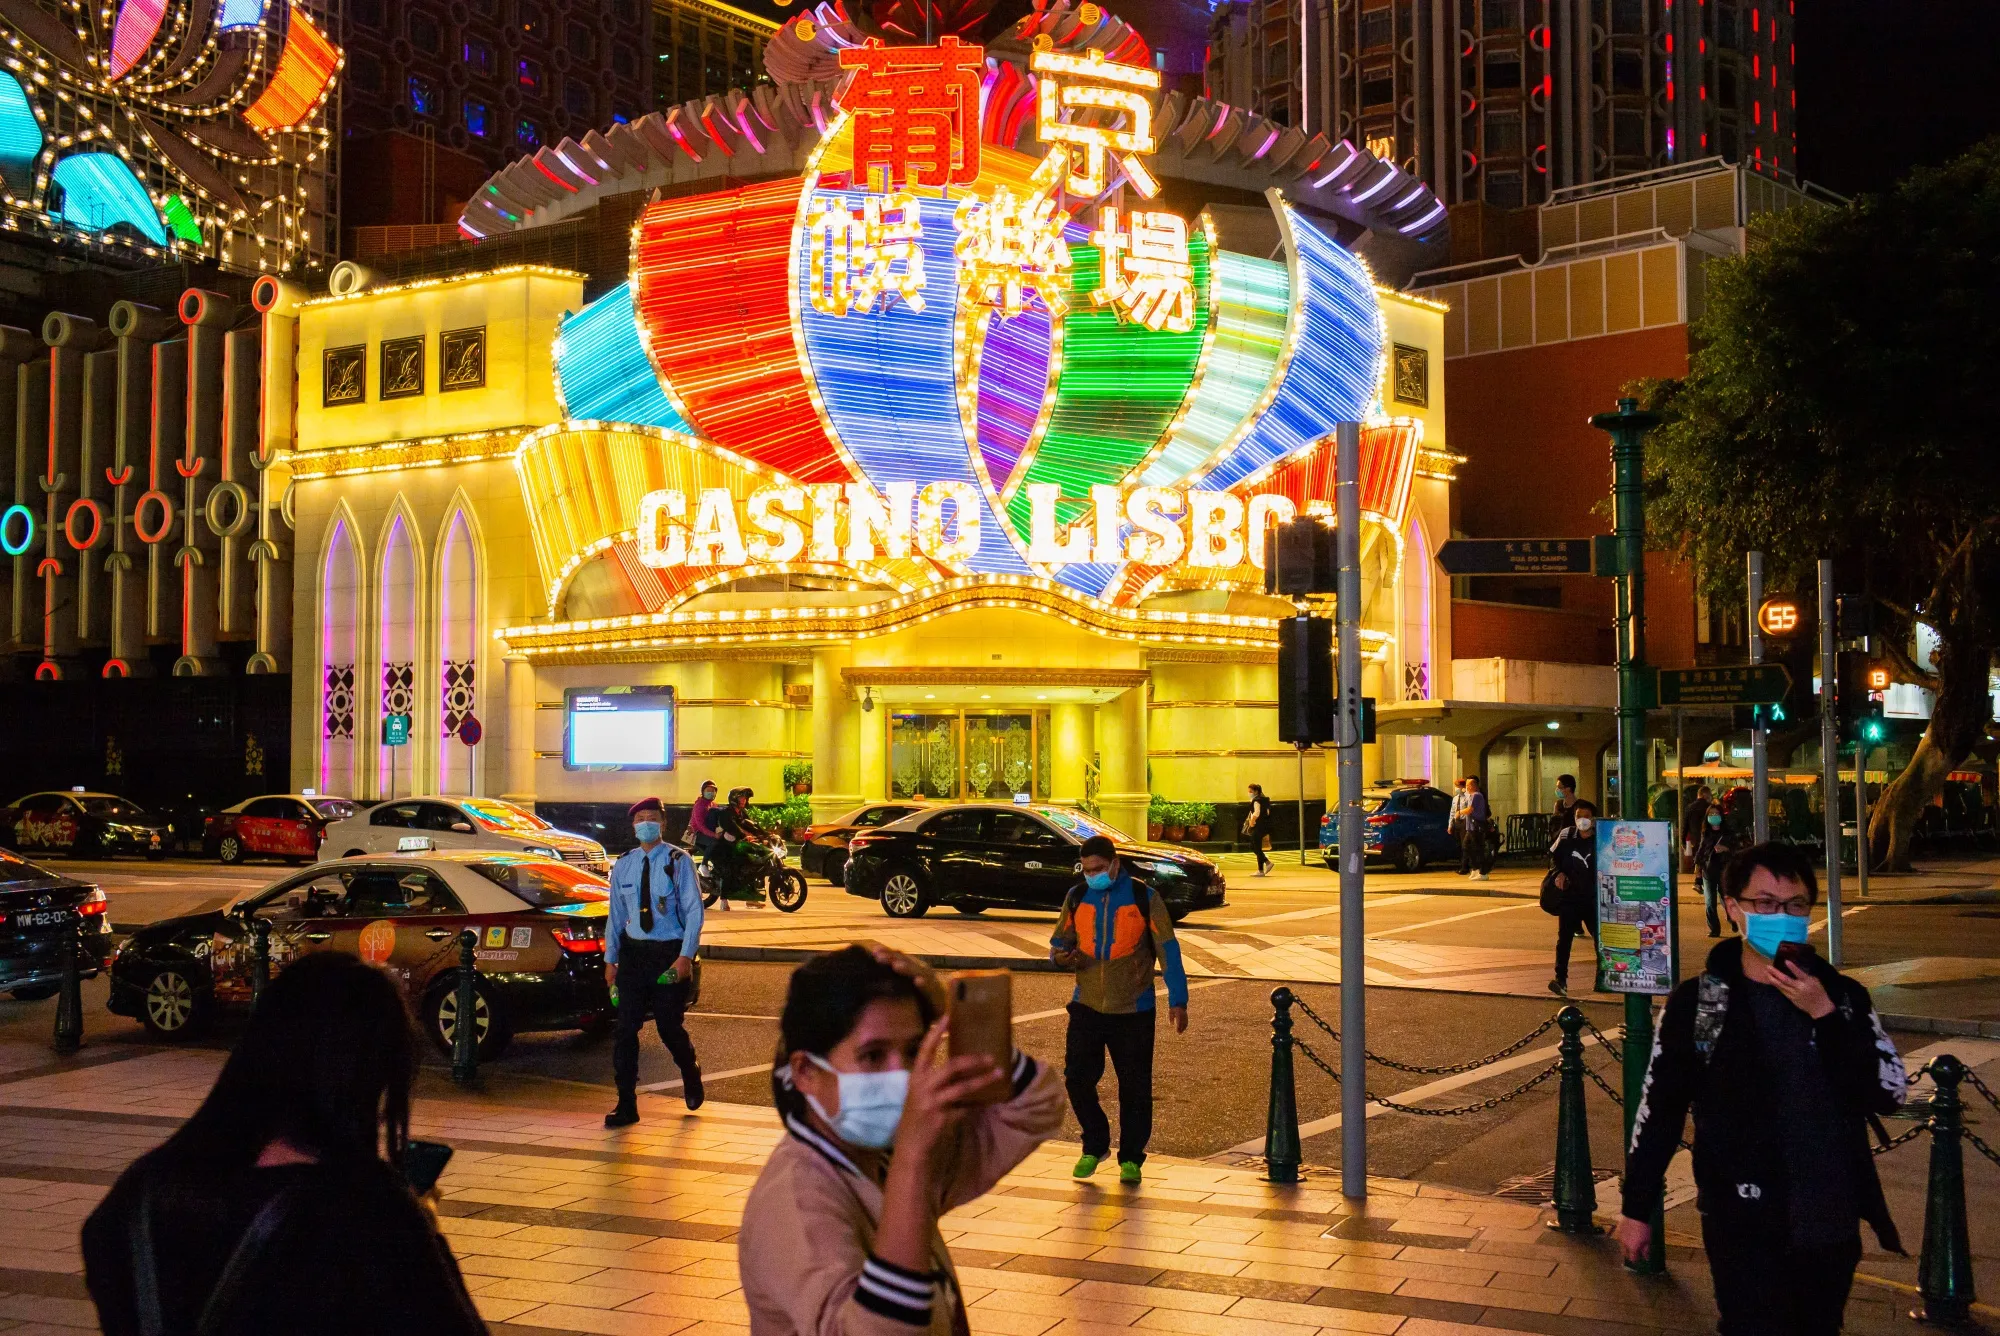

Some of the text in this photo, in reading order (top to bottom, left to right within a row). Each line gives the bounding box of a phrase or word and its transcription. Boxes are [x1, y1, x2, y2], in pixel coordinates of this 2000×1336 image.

[838, 35, 1162, 200] 葡京
[637, 480, 1336, 570] CASINO LISBO
[1768, 605, 1796, 629] 55
[1872, 671, 1886, 686] 13
[407, 839, 427, 848] TAXI
